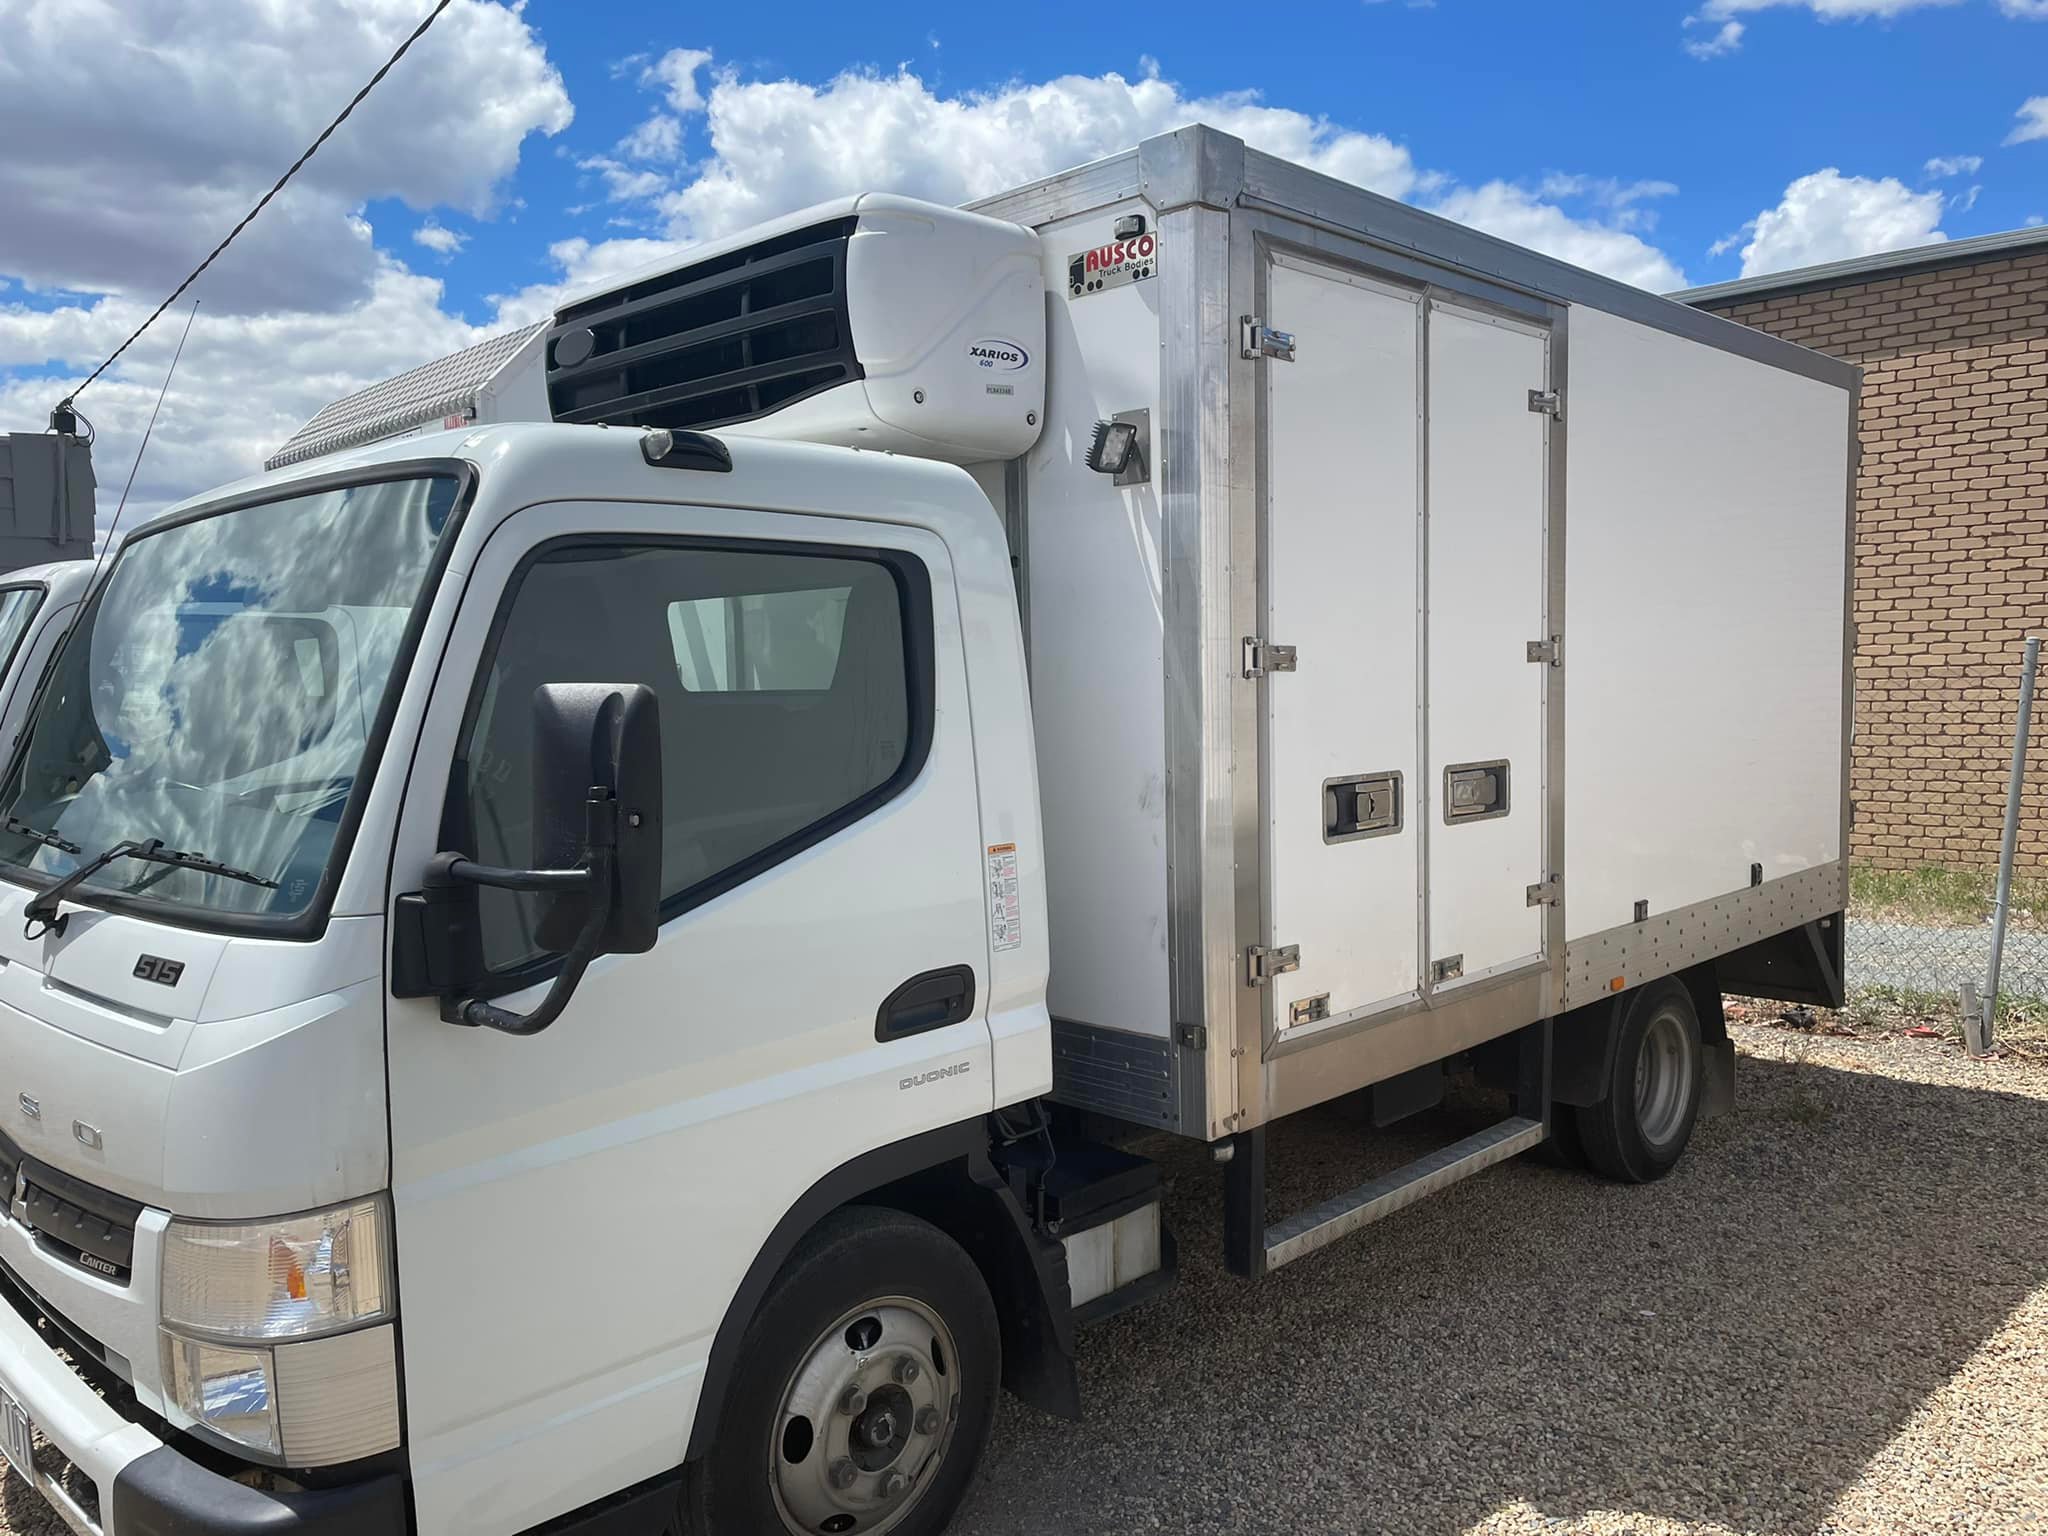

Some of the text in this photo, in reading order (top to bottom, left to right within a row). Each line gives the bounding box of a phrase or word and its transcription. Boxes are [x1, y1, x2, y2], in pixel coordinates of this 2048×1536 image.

[1086, 235, 1154, 272] AUSCO
[1099, 258, 1154, 278] Truck Bodies
[969, 347, 1019, 362] XARIOS
[979, 359, 994, 368] 600
[135, 956, 181, 983] 515
[899, 1061, 970, 1090] DUONIC
